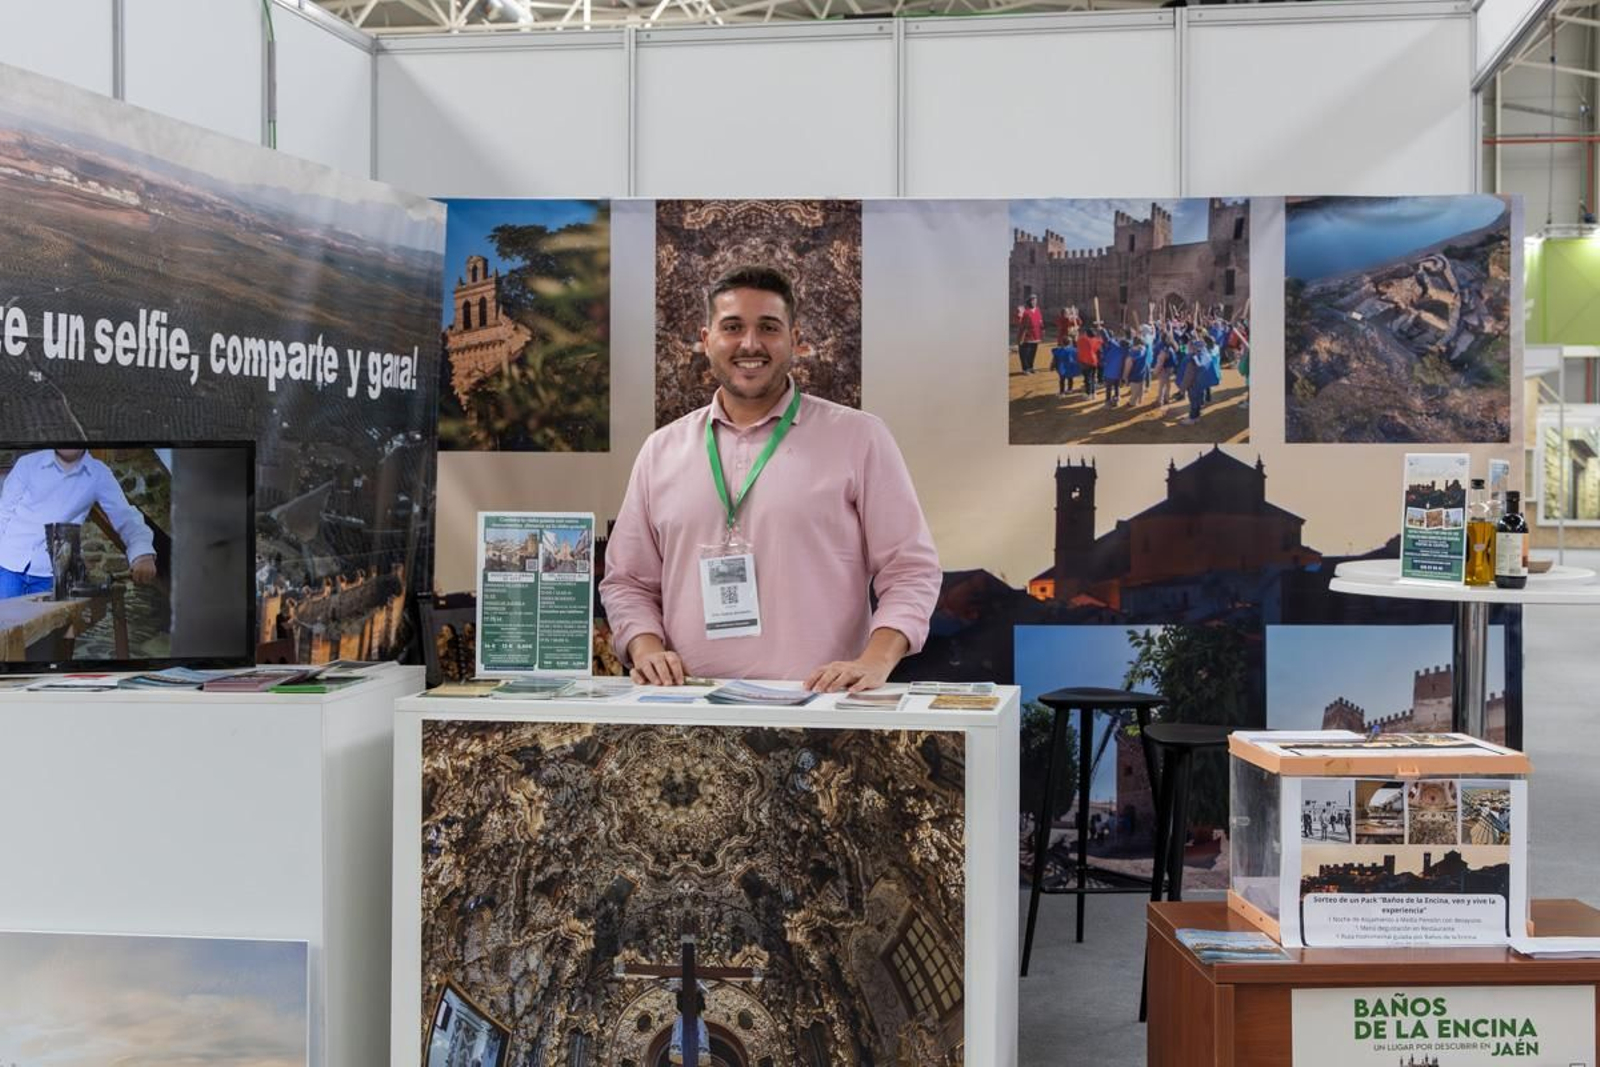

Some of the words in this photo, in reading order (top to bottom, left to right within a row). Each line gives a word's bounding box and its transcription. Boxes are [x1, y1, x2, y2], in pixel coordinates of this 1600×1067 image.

[43, 311, 85, 361] un
[93, 309, 200, 385] selfie,
[209, 332, 338, 392] comparte
[346, 347, 361, 398] y
[1313, 896, 1337, 904] Sorteo
[1424, 897, 1450, 905] Encina,
[1381, 906, 1427, 915] experiencia"
[1354, 992, 1447, 1017] BAÑOS
[1354, 1020, 1387, 1039] DE
[1396, 1019, 1429, 1039] LA
[1437, 1018, 1538, 1038] ENCINA
[1387, 1043, 1414, 1051] LUGAR
[1416, 1043, 1433, 1051] POR
[1434, 1042, 1478, 1050] DESCUBRIR
[1491, 1038, 1539, 1056] JAÉN
